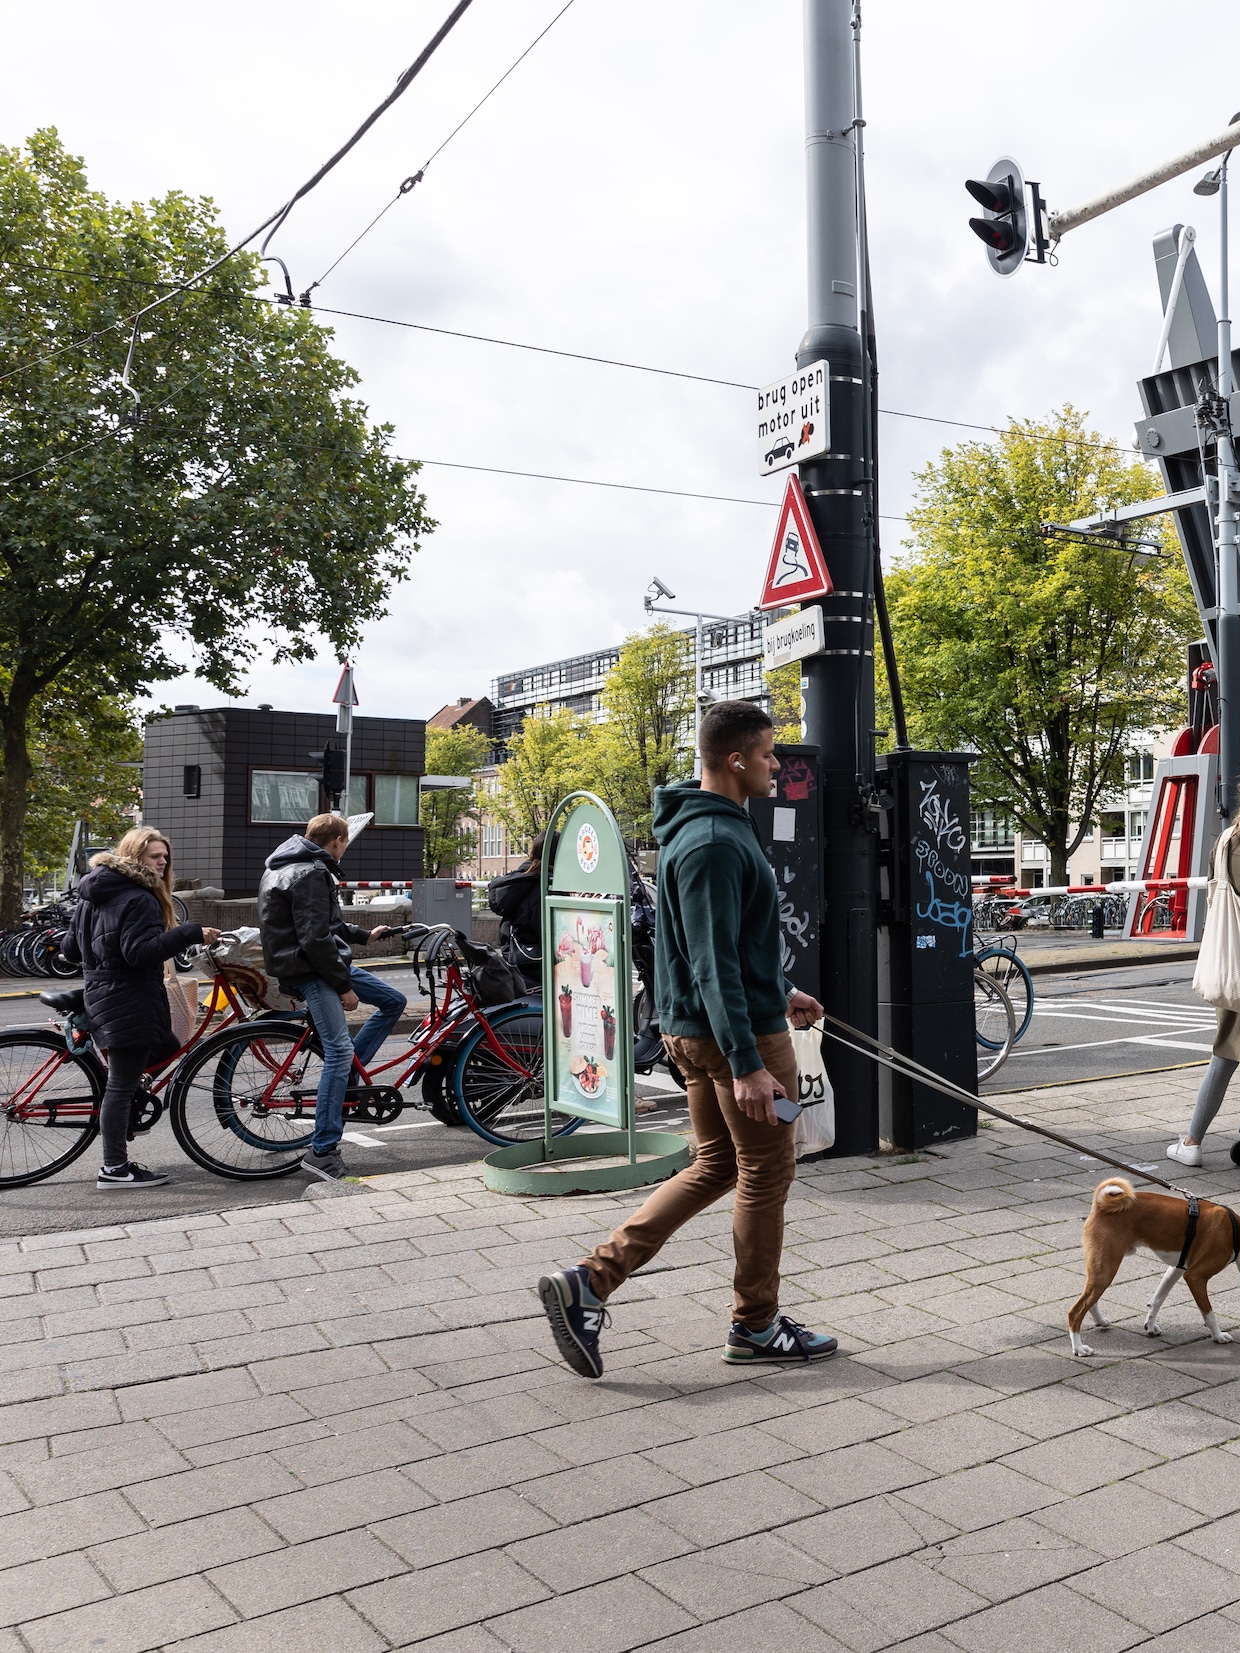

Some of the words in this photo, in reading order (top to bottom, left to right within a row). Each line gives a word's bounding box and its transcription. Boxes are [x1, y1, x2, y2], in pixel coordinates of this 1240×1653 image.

[758, 384, 786, 411] brug
[792, 367, 824, 396] open
[758, 409, 796, 438] motor
[801, 395, 820, 420] uit
[766, 635, 776, 657] bij
[776, 621, 816, 653] brugkoeling
[773, 1332, 795, 1352] N
